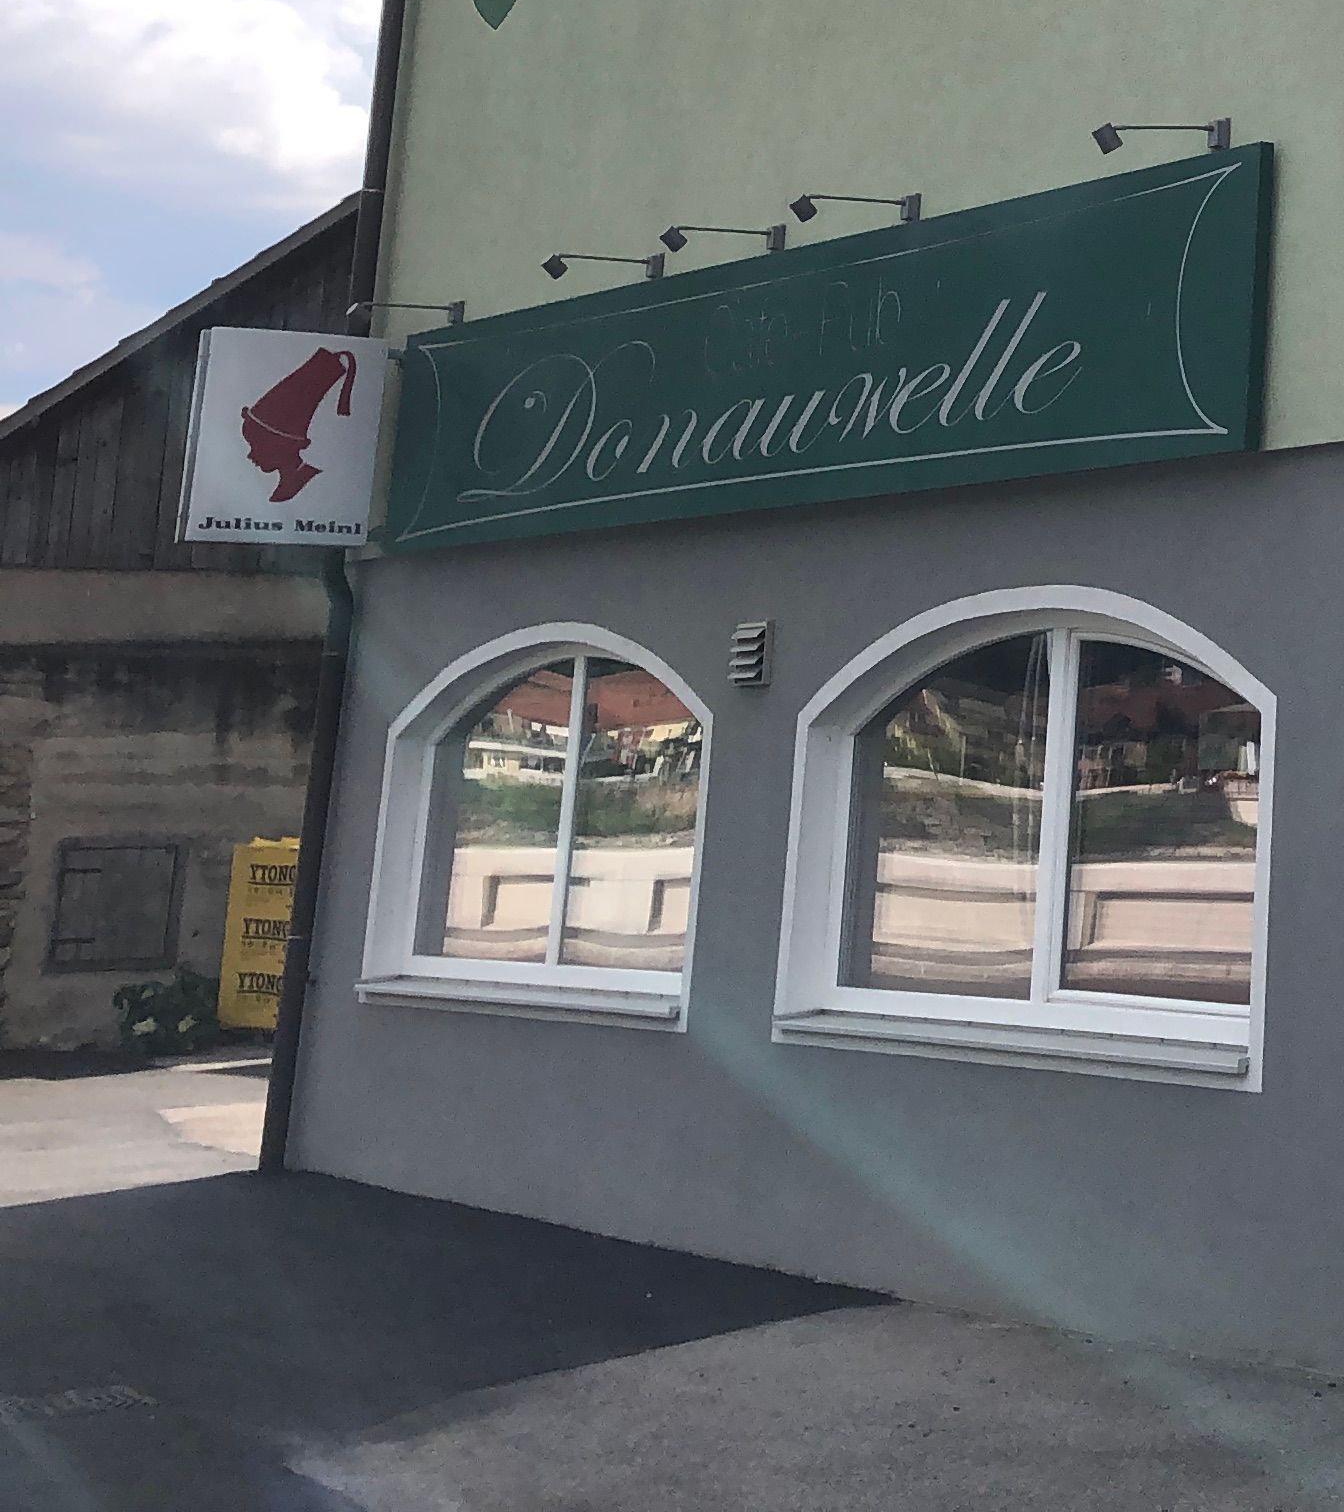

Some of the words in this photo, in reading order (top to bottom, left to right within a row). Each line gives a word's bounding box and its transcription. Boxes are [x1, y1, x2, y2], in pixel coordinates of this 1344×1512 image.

[456, 291, 1083, 503] Donauwelle
[198, 516, 284, 531] Julius
[294, 519, 362, 535] Meinl
